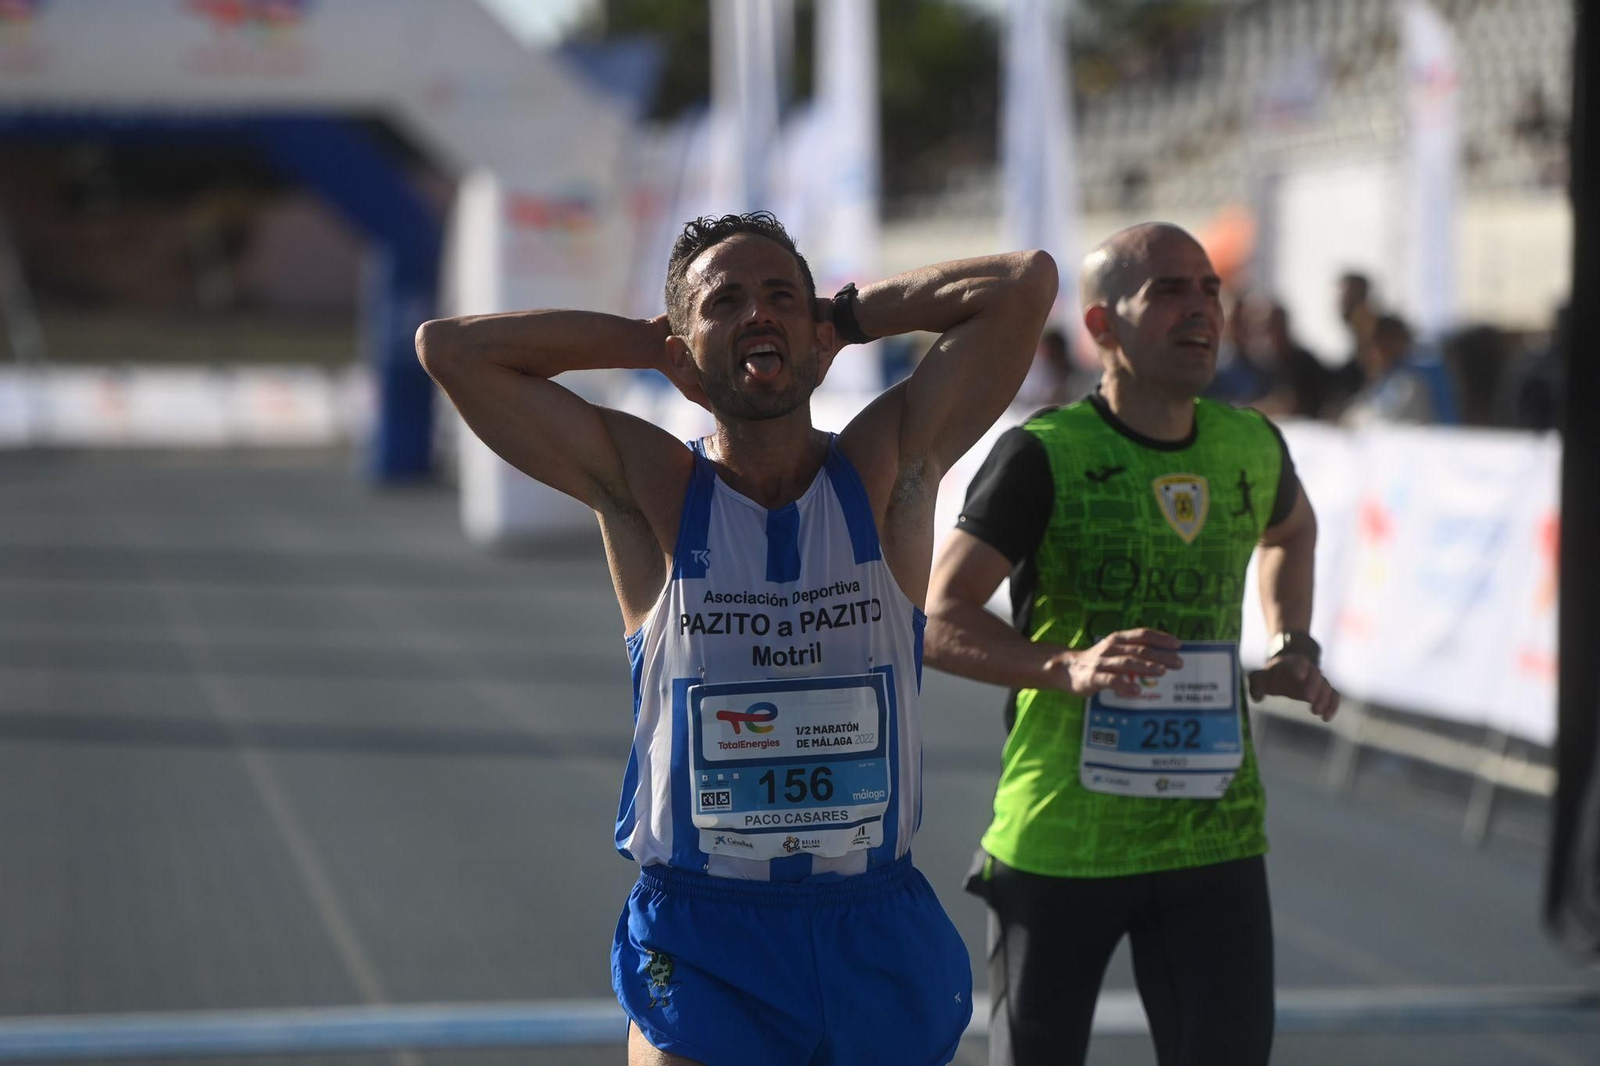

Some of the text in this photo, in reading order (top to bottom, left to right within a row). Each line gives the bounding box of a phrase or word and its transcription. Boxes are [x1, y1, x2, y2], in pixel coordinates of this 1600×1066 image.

[703, 581, 860, 607] Asociación Deportiva
[680, 598, 882, 637] PAZITO a PAZITO
[752, 641, 822, 667] Motril
[796, 722, 859, 735] 1/2 MARATÓN
[796, 733, 875, 748] DE MÁLAGA 2022
[1141, 719, 1201, 749] 252
[717, 739, 780, 750] TotalEnergies
[758, 766, 834, 804] 156
[745, 810, 849, 826] PACO CASARES
